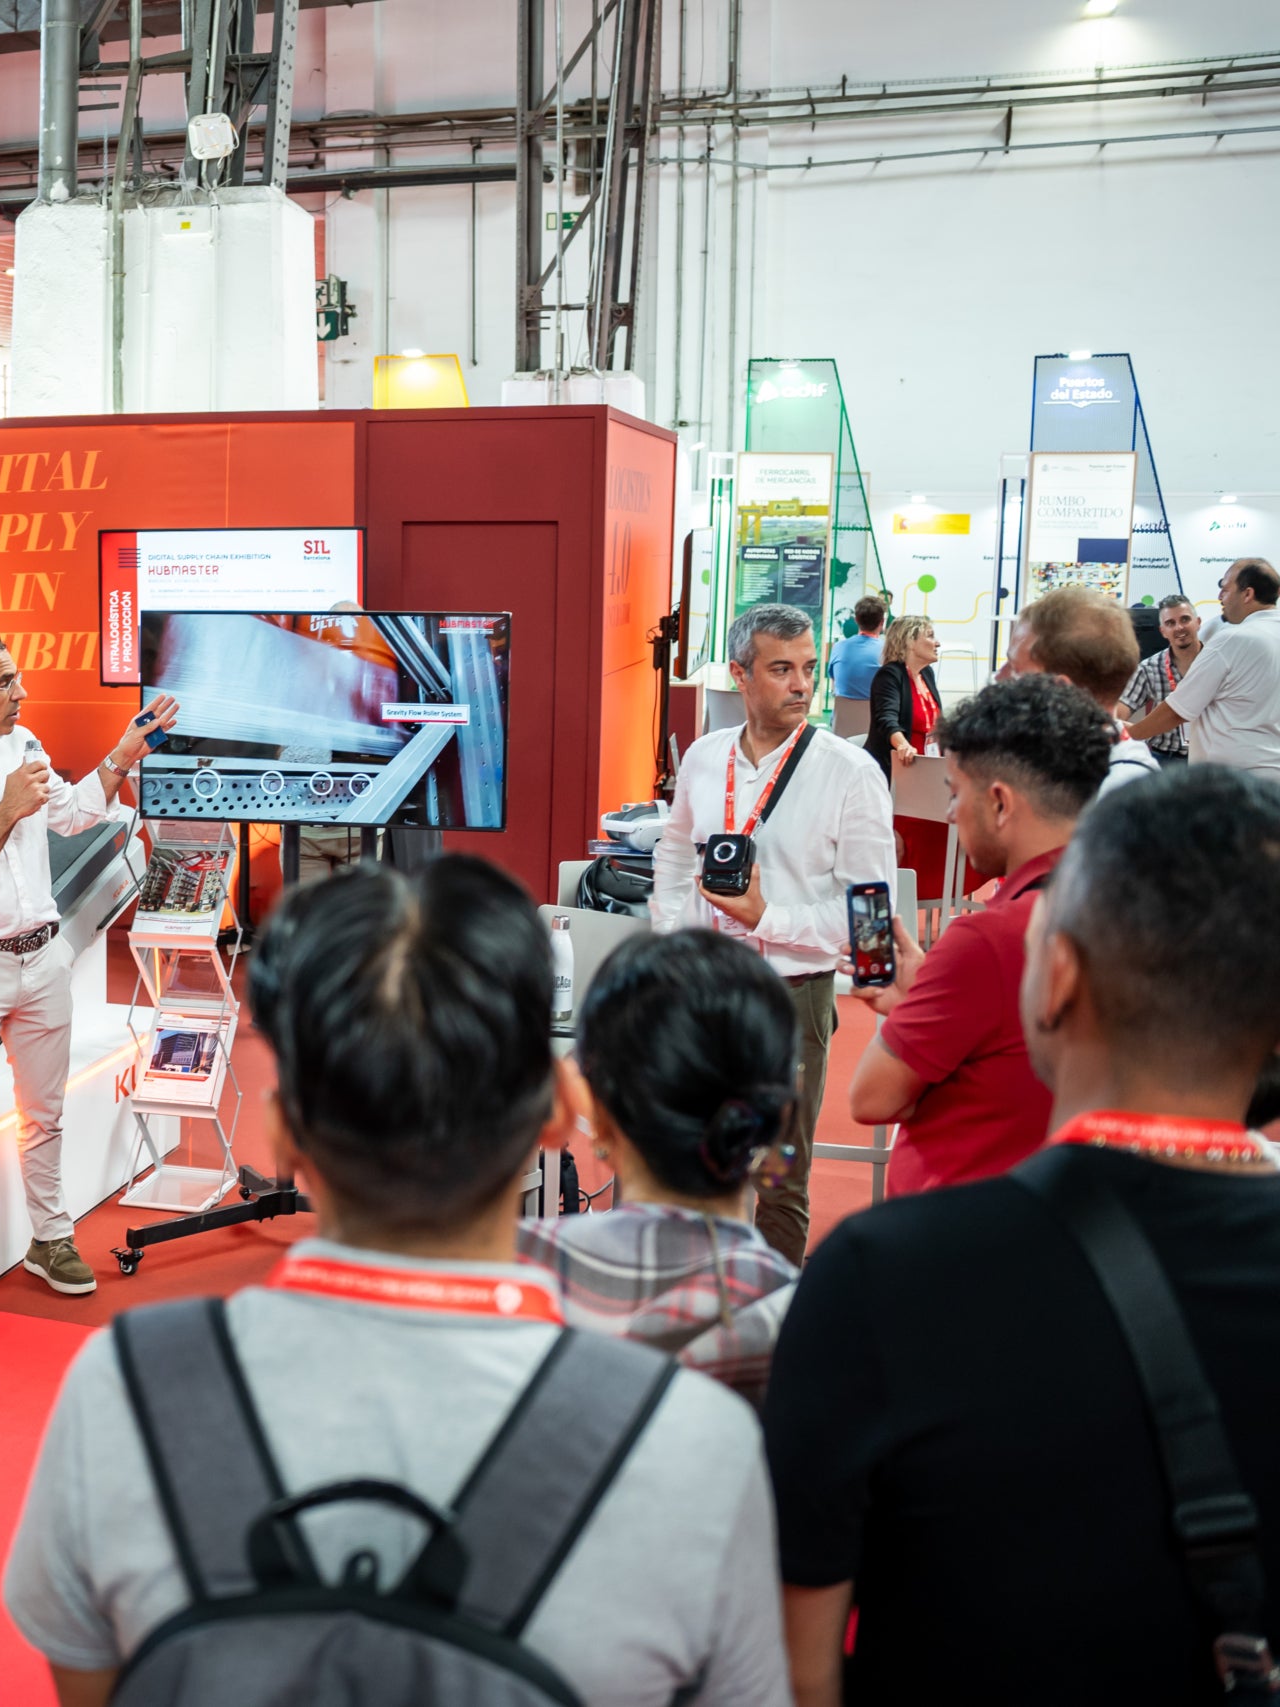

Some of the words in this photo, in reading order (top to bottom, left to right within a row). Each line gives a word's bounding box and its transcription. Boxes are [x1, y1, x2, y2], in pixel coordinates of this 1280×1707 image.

[1059, 376, 1105, 389] Puertos
[1050, 388, 1070, 401] del
[1072, 388, 1113, 401] Estado
[1038, 495, 1086, 506] RUMBO
[1037, 507, 1123, 518] COMPARTIDO
[303, 539, 331, 555] SIL
[230, 552, 272, 560] EXHIBITION
[148, 565, 219, 576] HUBMASTER
[108, 589, 120, 673] INTRALOGÍSTICA
[121, 591, 132, 662] PRODUCCIÓN
[122, 663, 132, 673] Y
